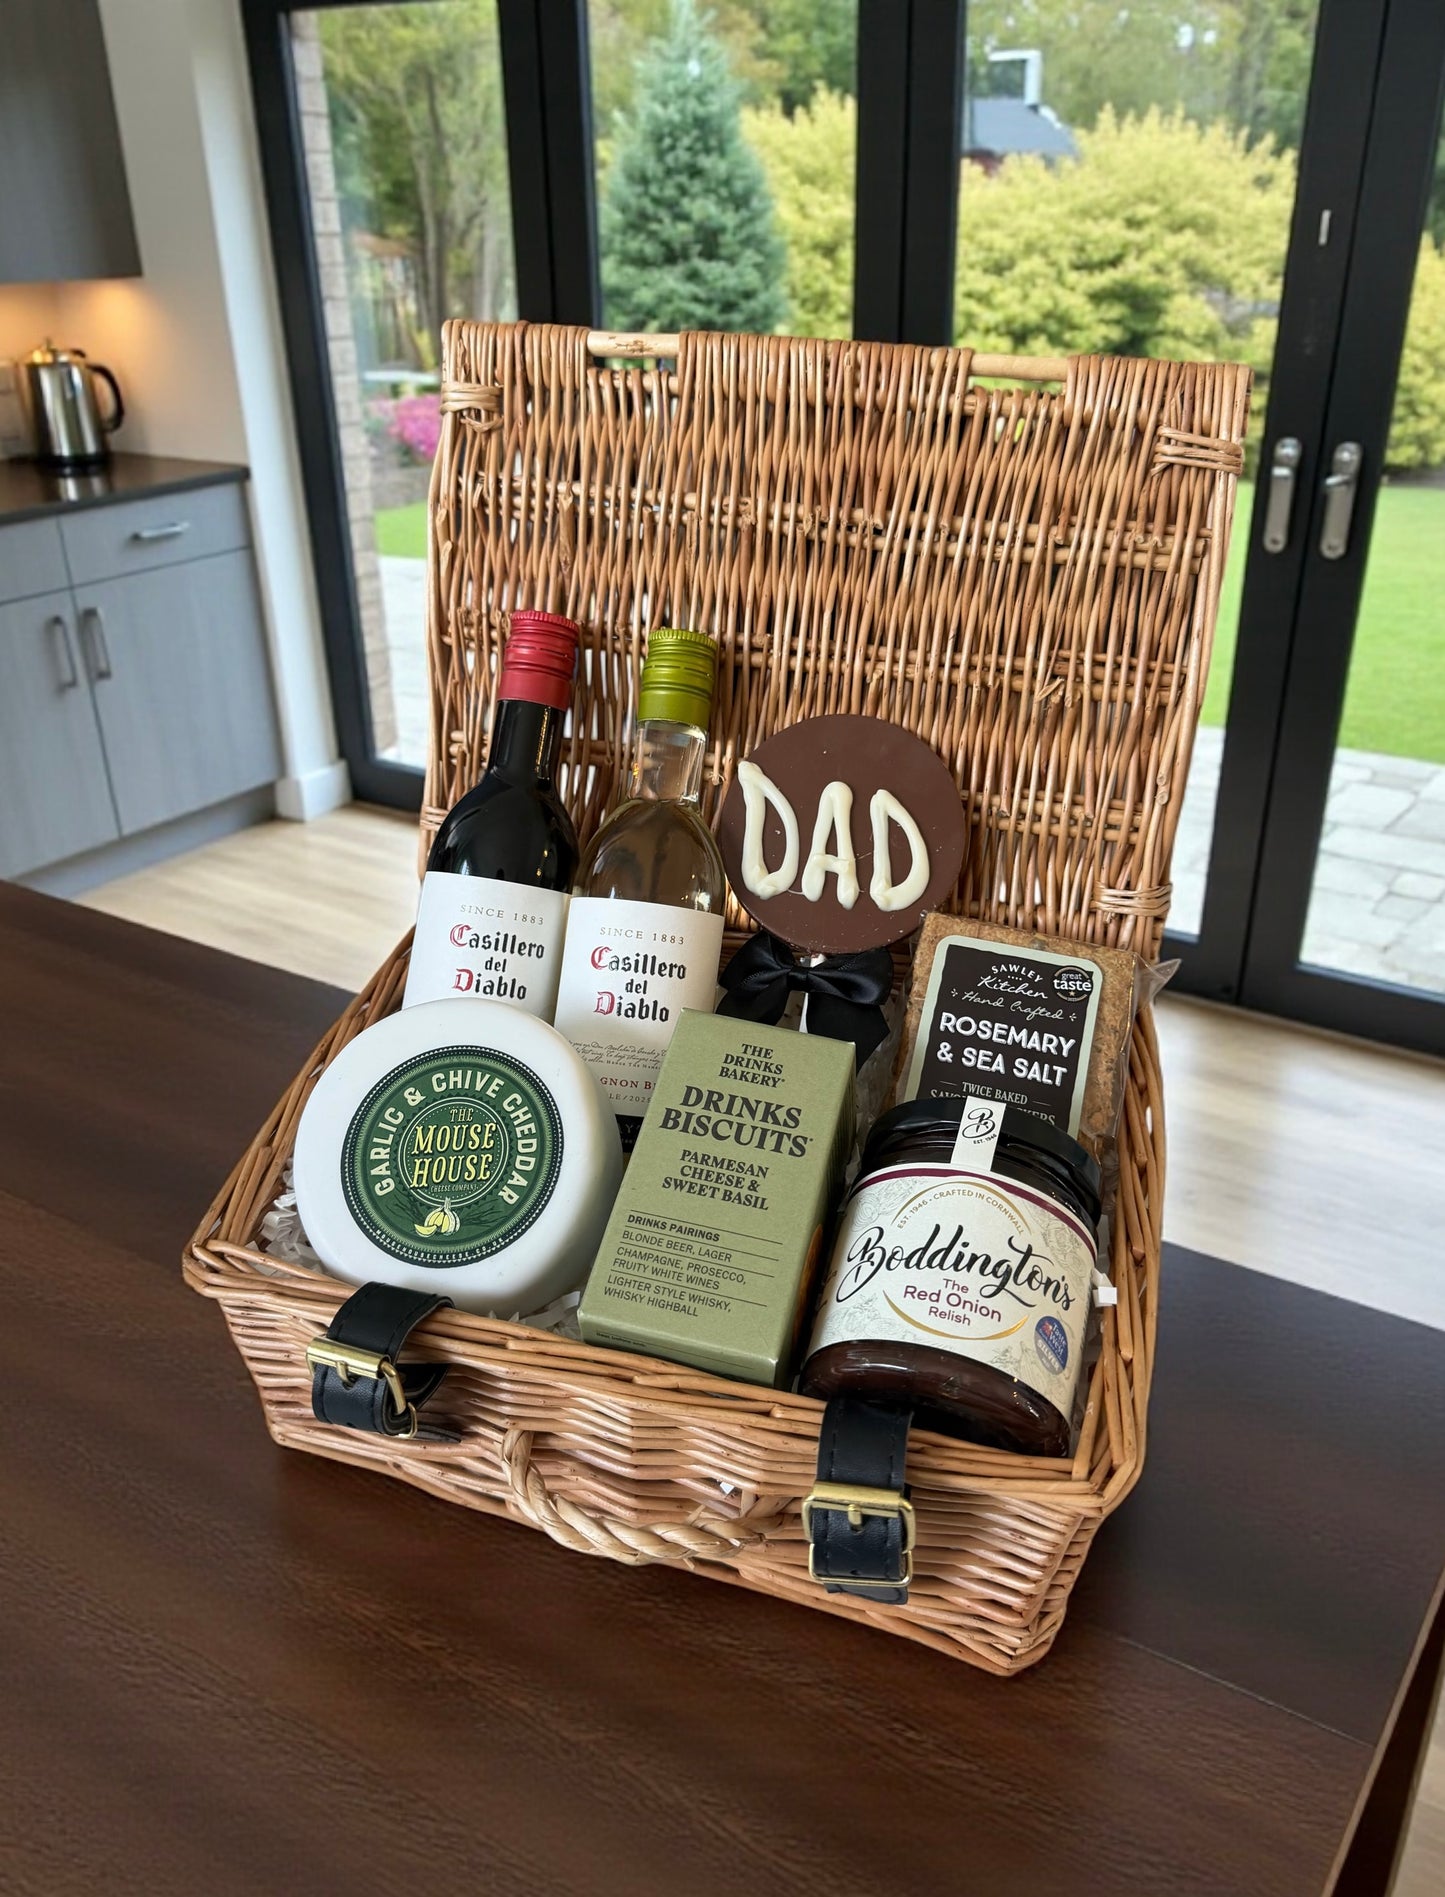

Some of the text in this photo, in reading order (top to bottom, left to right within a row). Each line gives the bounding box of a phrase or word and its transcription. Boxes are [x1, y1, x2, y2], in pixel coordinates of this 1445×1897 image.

[737, 760, 930, 912] DAD
[460, 904, 545, 926] SINCE 1883
[449, 923, 545, 959] Casillero
[599, 926, 685, 945] SINCE 1883
[484, 956, 506, 973] del
[590, 945, 686, 980] Casillero
[991, 963, 1043, 983] SAWLEY
[1061, 973, 1082, 981] great
[452, 968, 527, 1000] Diablo
[625, 979, 648, 995] del
[977, 975, 1048, 999] Kitchen
[1053, 979, 1092, 991] taste
[593, 991, 669, 1023] Diablo
[962, 990, 1064, 1021] Hand Crafted
[939, 1011, 1076, 1058] ROSEMARY
[723, 1053, 784, 1075] DRINKS
[741, 1043, 774, 1060] THE
[936, 1042, 1068, 1087] & SEA SALT
[600, 1076, 640, 1089] GNON
[718, 1066, 783, 1088] BAKERY
[679, 1085, 802, 1129] DRINKS
[962, 1081, 993, 1098] TWICE
[994, 1088, 1028, 1105] BAKED
[449, 1108, 474, 1122] THE
[370, 1069, 538, 1205] GARLIC & CHIVE CHEDDAR
[411, 1122, 497, 1155] MOUSE
[659, 1107, 810, 1158] BISCUITS
[410, 1154, 493, 1189] HOUSE
[680, 1149, 770, 1179] PARMESAN
[680, 1164, 761, 1192] CHEESE &
[430, 1185, 451, 1193] CHEESE
[662, 1176, 769, 1211] SWEET BASIL
[896, 1188, 1025, 1236] EST. 1946 CRAFTED IN CORNWALL
[627, 1214, 721, 1242] DRINKS PAIRINGS
[622, 1230, 733, 1263] BLONDE BEER, LAGER
[612, 1257, 720, 1291] FRUITY WHITE WINES
[616, 1246, 747, 1286] CHAMPAGNE, PROSECCO,
[835, 1223, 1076, 1311] Boddington's
[607, 1274, 732, 1313] LIGHTER STYLE WHISKY,
[942, 1278, 969, 1294] The
[603, 1286, 699, 1318] WHISKY HIGHBALL
[903, 1285, 1002, 1323] Red Onion
[928, 1306, 971, 1326] Relish
